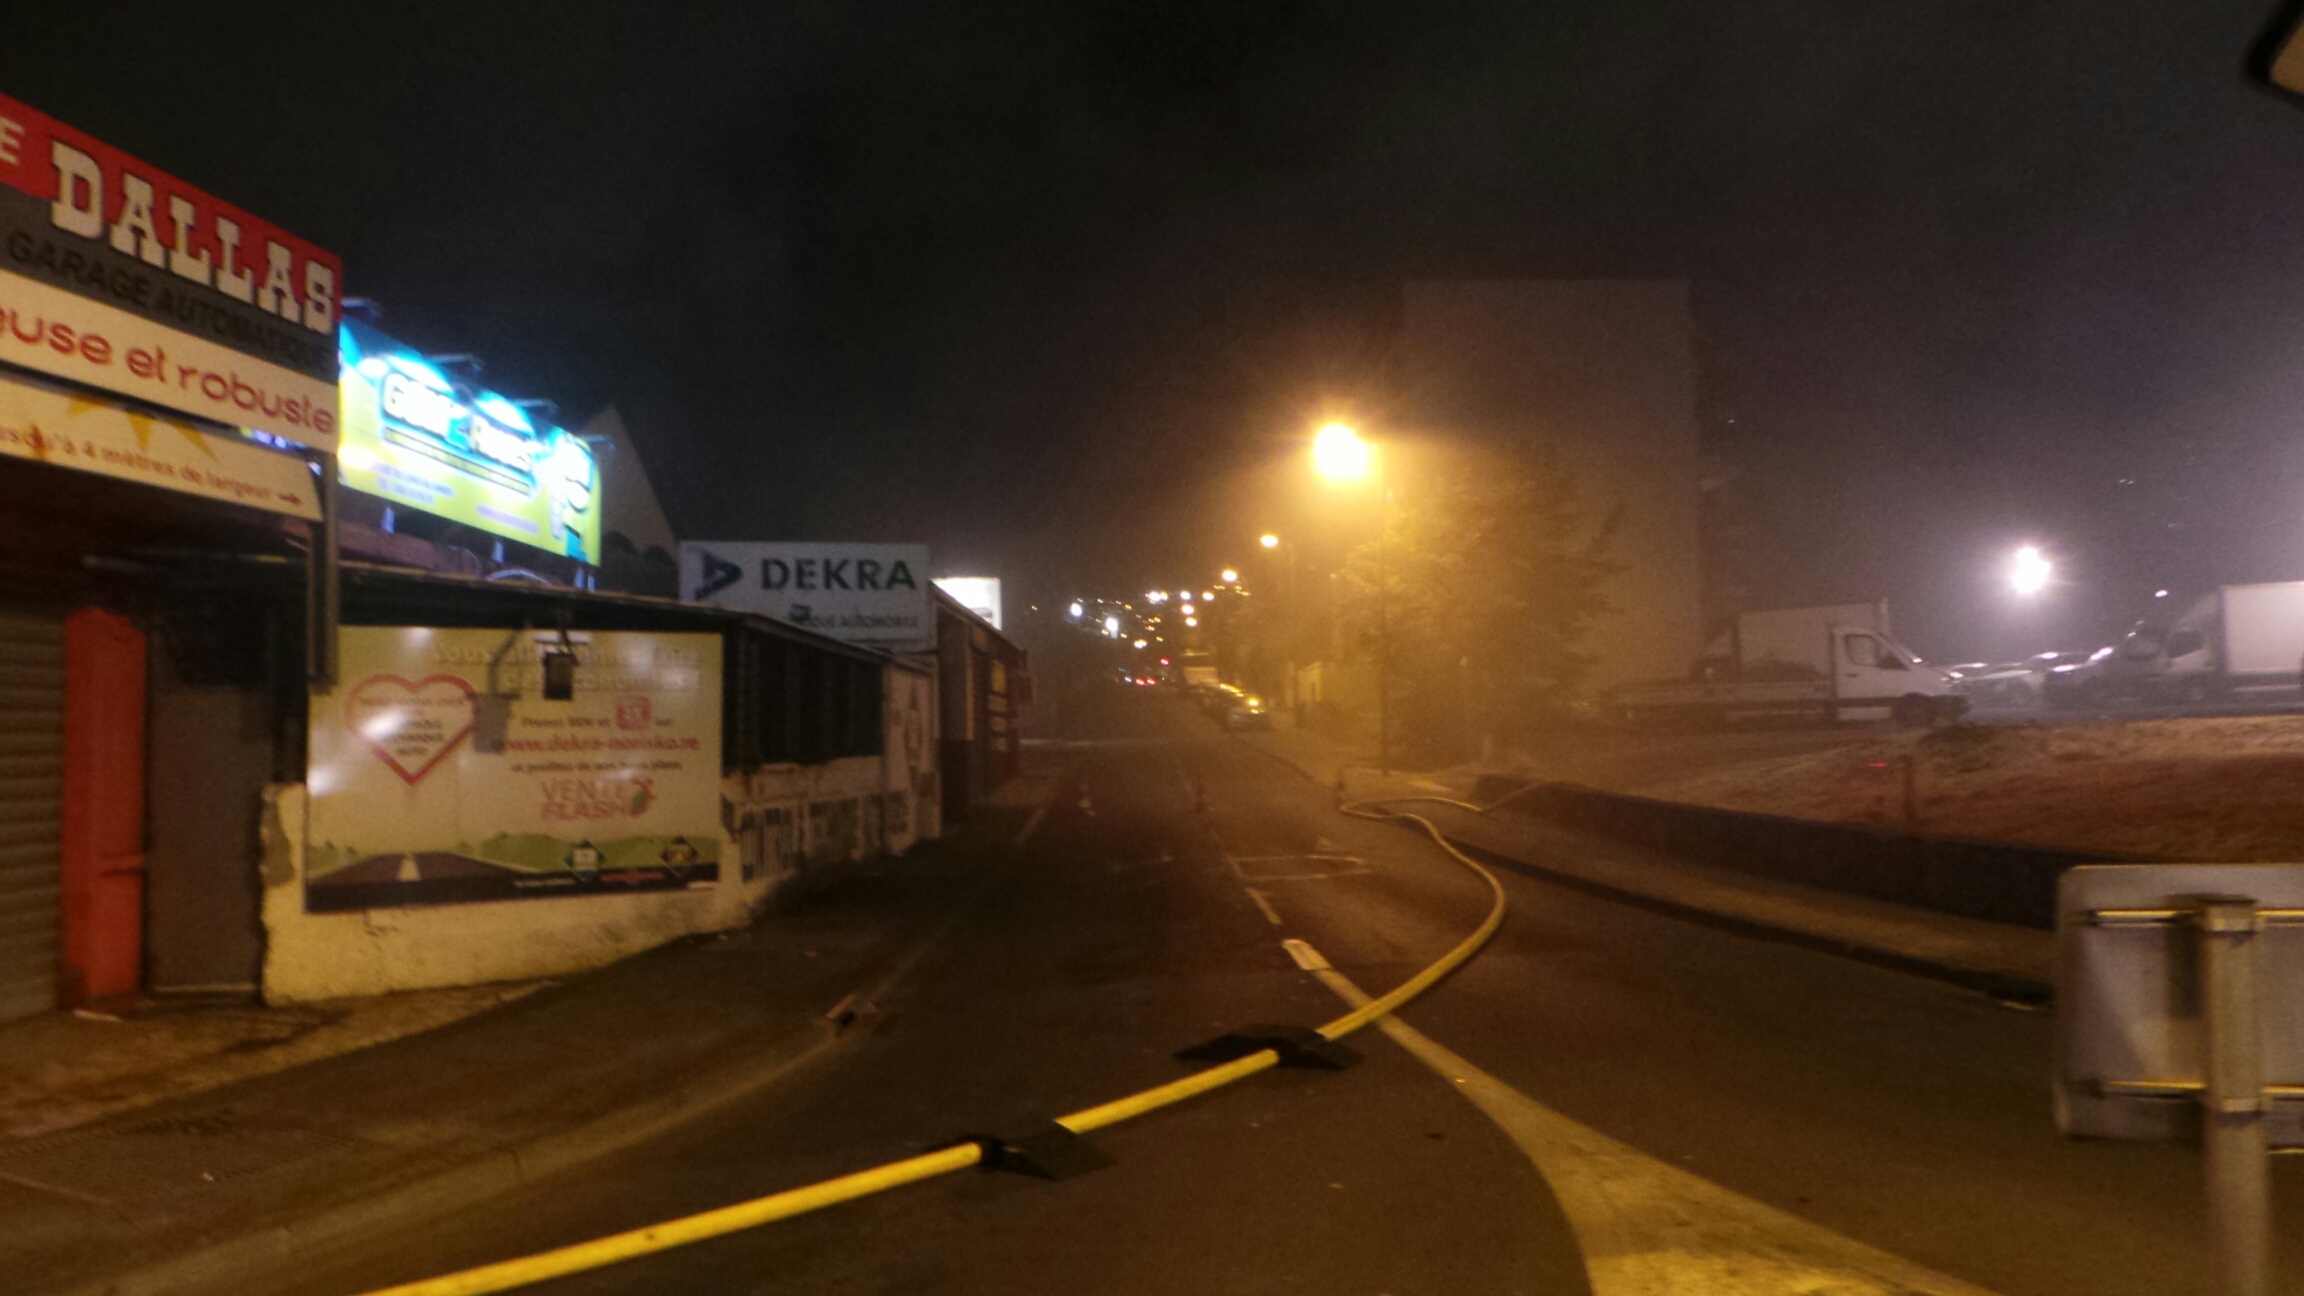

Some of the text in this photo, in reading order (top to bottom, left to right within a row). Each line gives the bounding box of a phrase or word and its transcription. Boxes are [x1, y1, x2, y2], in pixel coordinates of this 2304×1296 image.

[8, 231, 149, 307] GARAGE
[52, 139, 334, 335] DALLAS
[0, 307, 112, 365] use
[125, 345, 167, 384] et
[177, 364, 335, 434] robuste
[761, 558, 917, 591] DEKRA
[541, 801, 631, 822] FLASH
